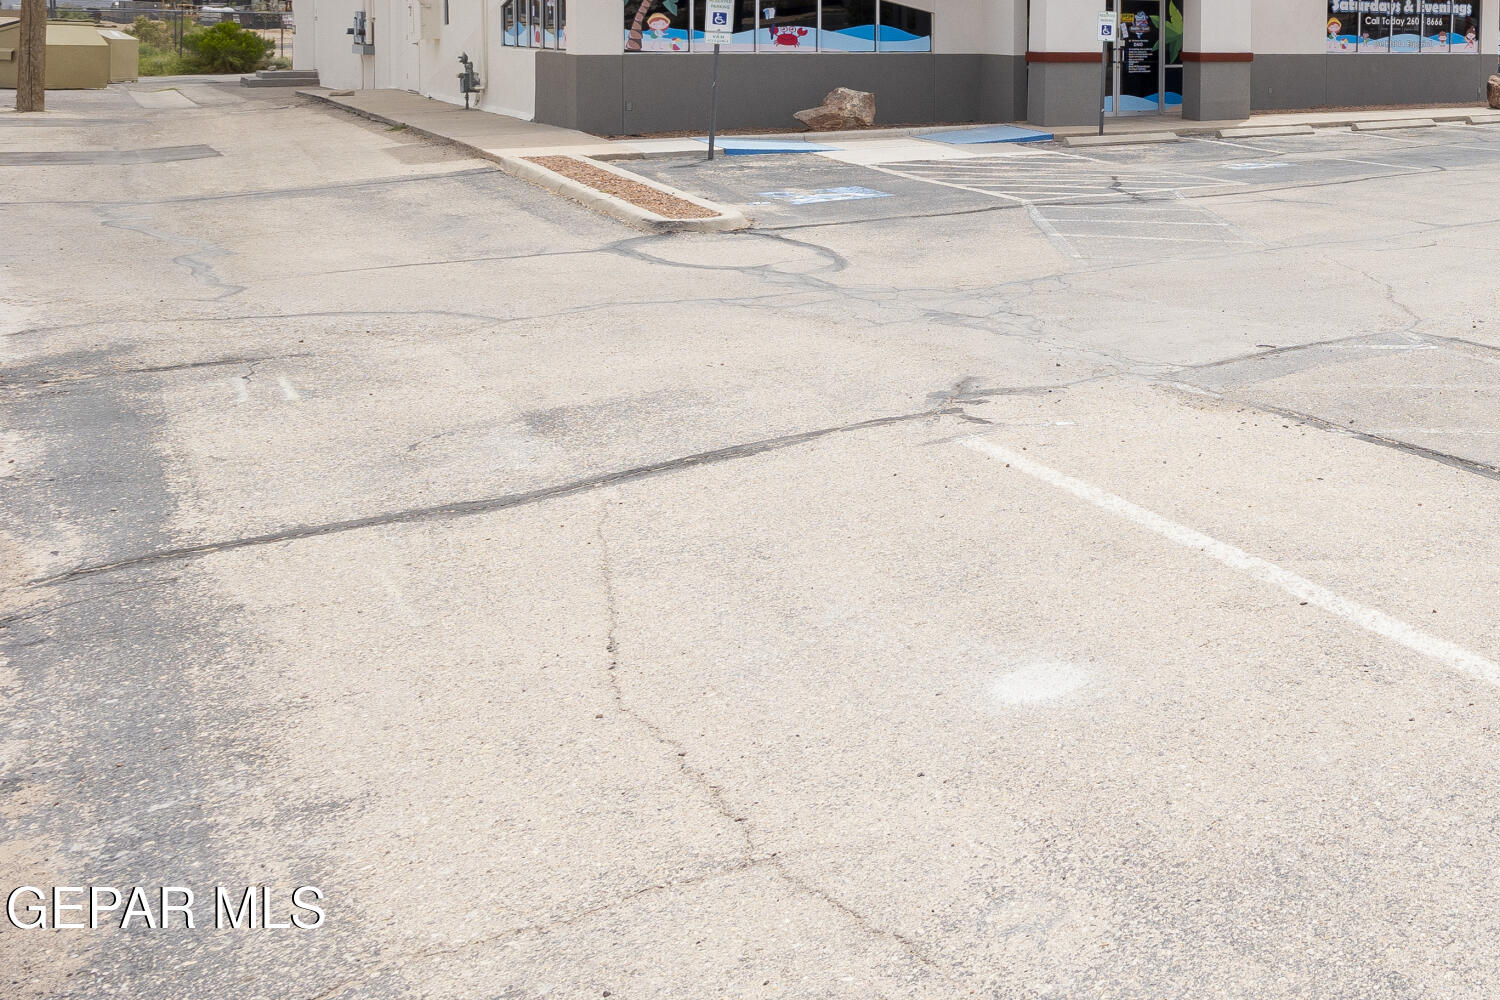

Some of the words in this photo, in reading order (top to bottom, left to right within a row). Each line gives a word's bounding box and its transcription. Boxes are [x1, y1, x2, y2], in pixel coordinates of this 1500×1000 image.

[1403, 0, 1414, 13] &
[1416, 0, 1472, 15] Evenings
[1365, 17, 1379, 25] Call
[1382, 17, 1405, 26] Today
[1406, 17, 1419, 25] 260
[1426, 18, 1443, 26] 8666
